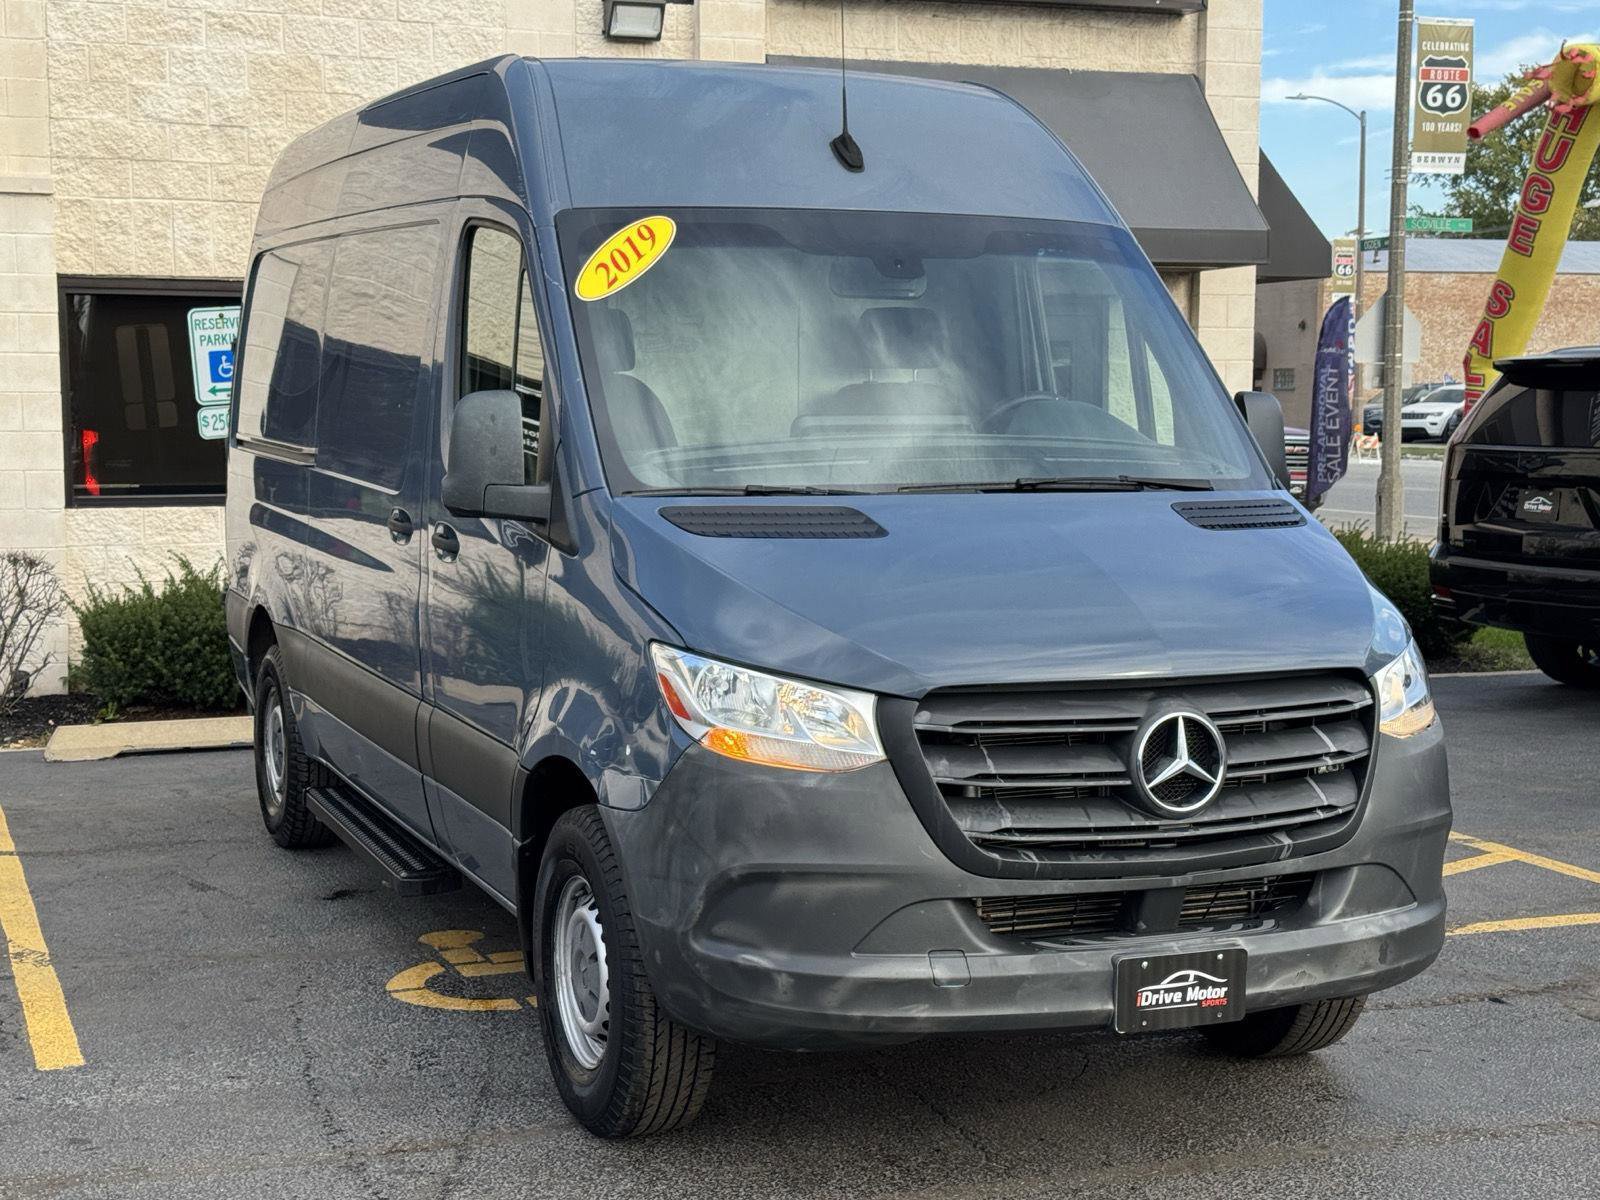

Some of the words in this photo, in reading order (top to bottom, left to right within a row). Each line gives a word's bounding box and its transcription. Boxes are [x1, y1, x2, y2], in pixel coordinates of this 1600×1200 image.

[1422, 41, 1470, 52] CELEBRATING
[1429, 70, 1460, 81] ROUTE
[1426, 84, 1462, 108] 66
[1422, 122, 1435, 132] 100
[1437, 122, 1462, 133] YEARS!
[1416, 155, 1461, 164] BERWYN
[1507, 103, 1592, 257] HUGE
[594, 224, 656, 289] 2019
[1337, 264, 1352, 275] 66
[1326, 368, 1340, 429] EVENT
[1317, 368, 1328, 482] PRE-APPROVAL
[1326, 435, 1341, 483] SALE
[1136, 990, 1182, 1008] iDrive
[1186, 986, 1228, 1001] Motor
[1201, 998, 1228, 1008] SPORTS
